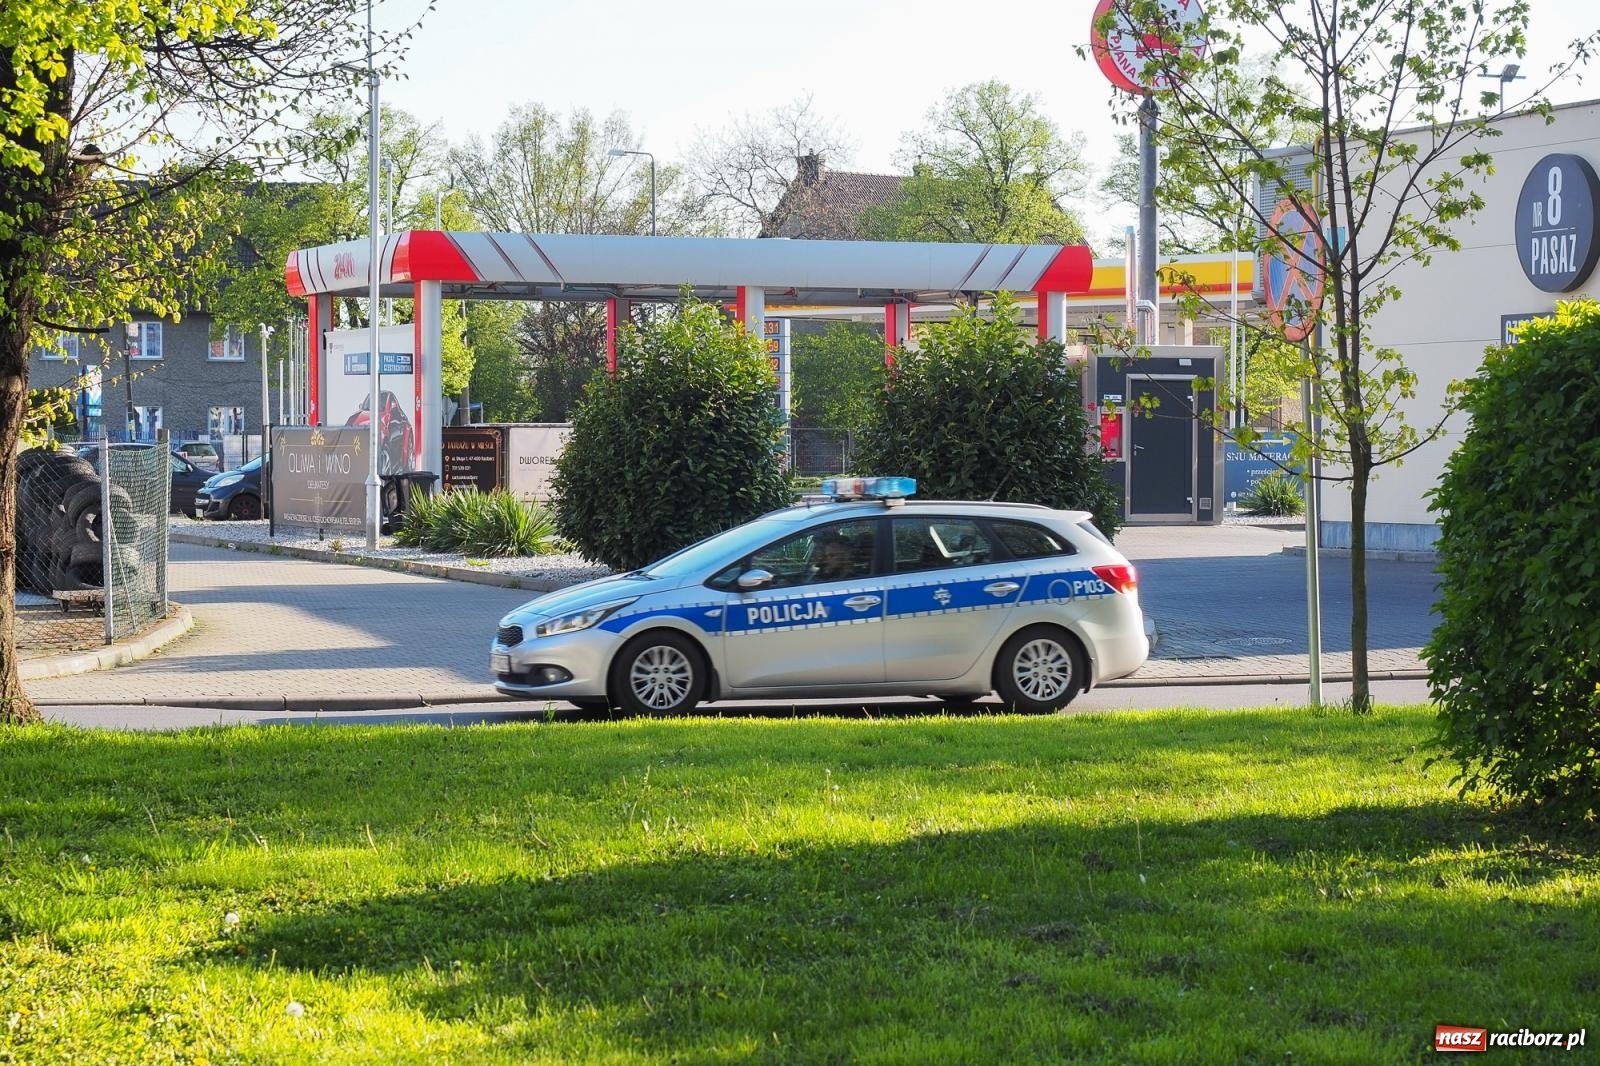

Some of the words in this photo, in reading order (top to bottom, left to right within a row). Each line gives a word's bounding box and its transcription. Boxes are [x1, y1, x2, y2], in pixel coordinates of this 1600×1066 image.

[1532, 201, 1543, 228] NR
[1547, 166, 1563, 226] 8
[325, 453, 351, 474] WINO
[1226, 452, 1246, 461] SNU
[1073, 579, 1106, 595] P103
[747, 601, 827, 625] POLICJA
